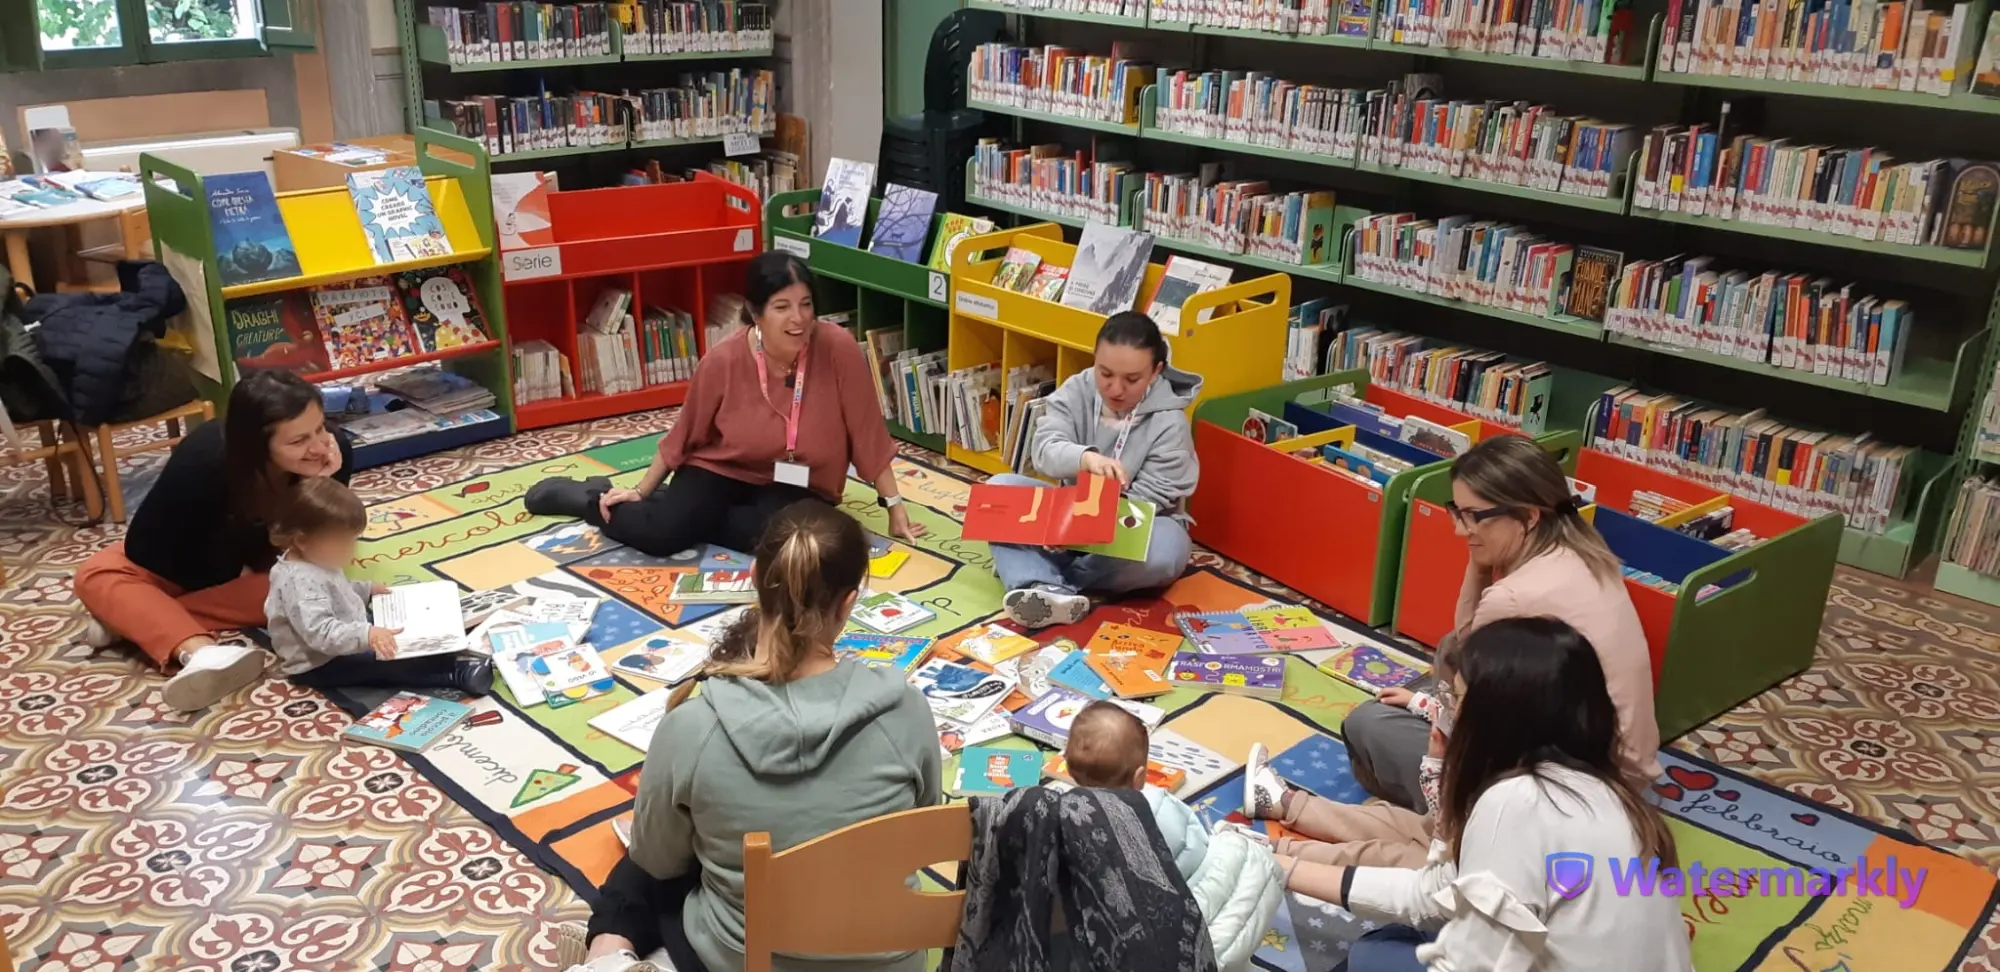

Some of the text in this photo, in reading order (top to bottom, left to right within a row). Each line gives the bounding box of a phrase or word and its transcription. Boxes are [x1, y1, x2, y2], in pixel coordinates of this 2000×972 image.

[513, 253, 552, 271] Serie
[934, 275, 943, 296] 2
[231, 309, 279, 330] DRAGHI
[918, 481, 969, 501] lugli
[352, 511, 537, 570] mercole
[433, 734, 518, 786] dicemb
[1680, 793, 1847, 864] febbraio
